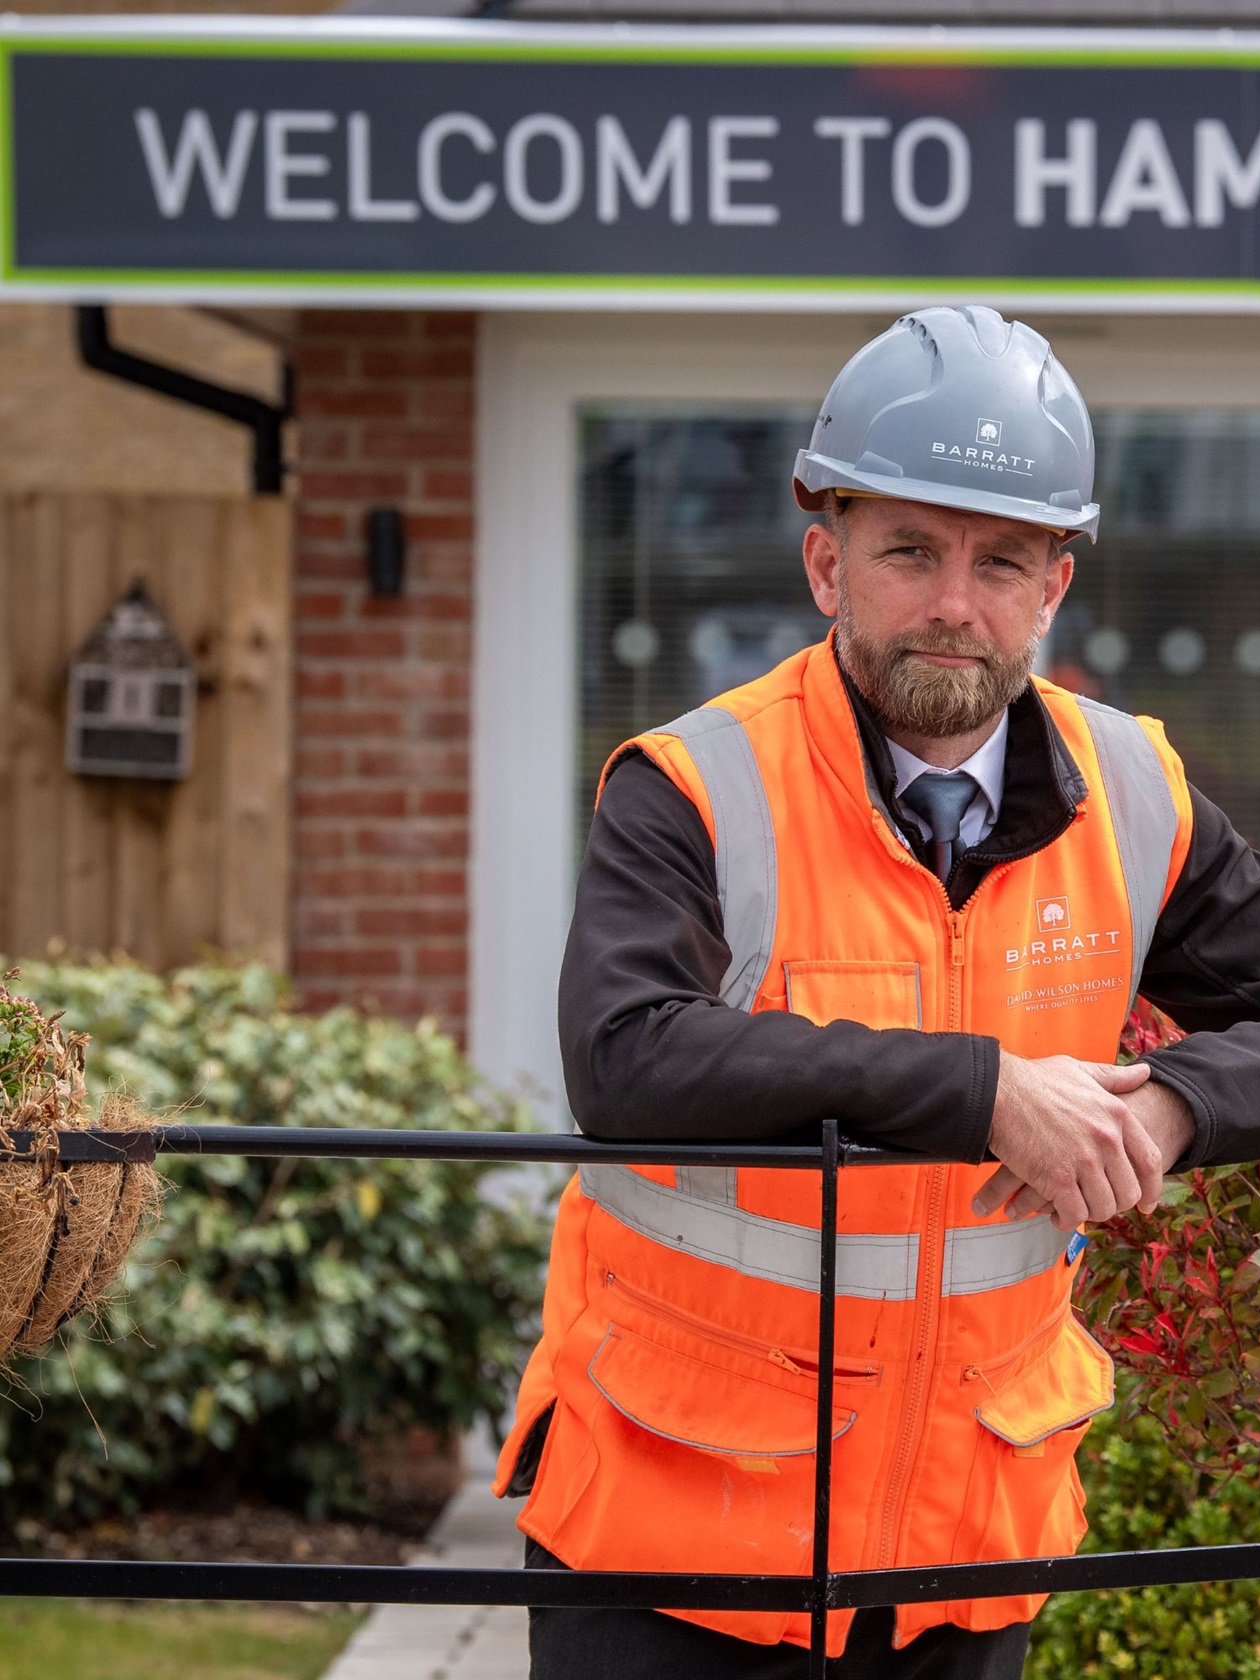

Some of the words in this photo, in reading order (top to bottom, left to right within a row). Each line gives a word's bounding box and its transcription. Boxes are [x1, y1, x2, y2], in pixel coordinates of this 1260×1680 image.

[134, 107, 780, 226] WELCOME
[814, 115, 972, 228] TO
[932, 442, 1035, 469] BARRATT
[964, 460, 1003, 471] HOMES
[1032, 952, 1082, 966] HOMES
[1036, 983, 1080, 997] WILSON
[1083, 977, 1123, 990] HOMES
[1080, 995, 1098, 1003] LIVES
